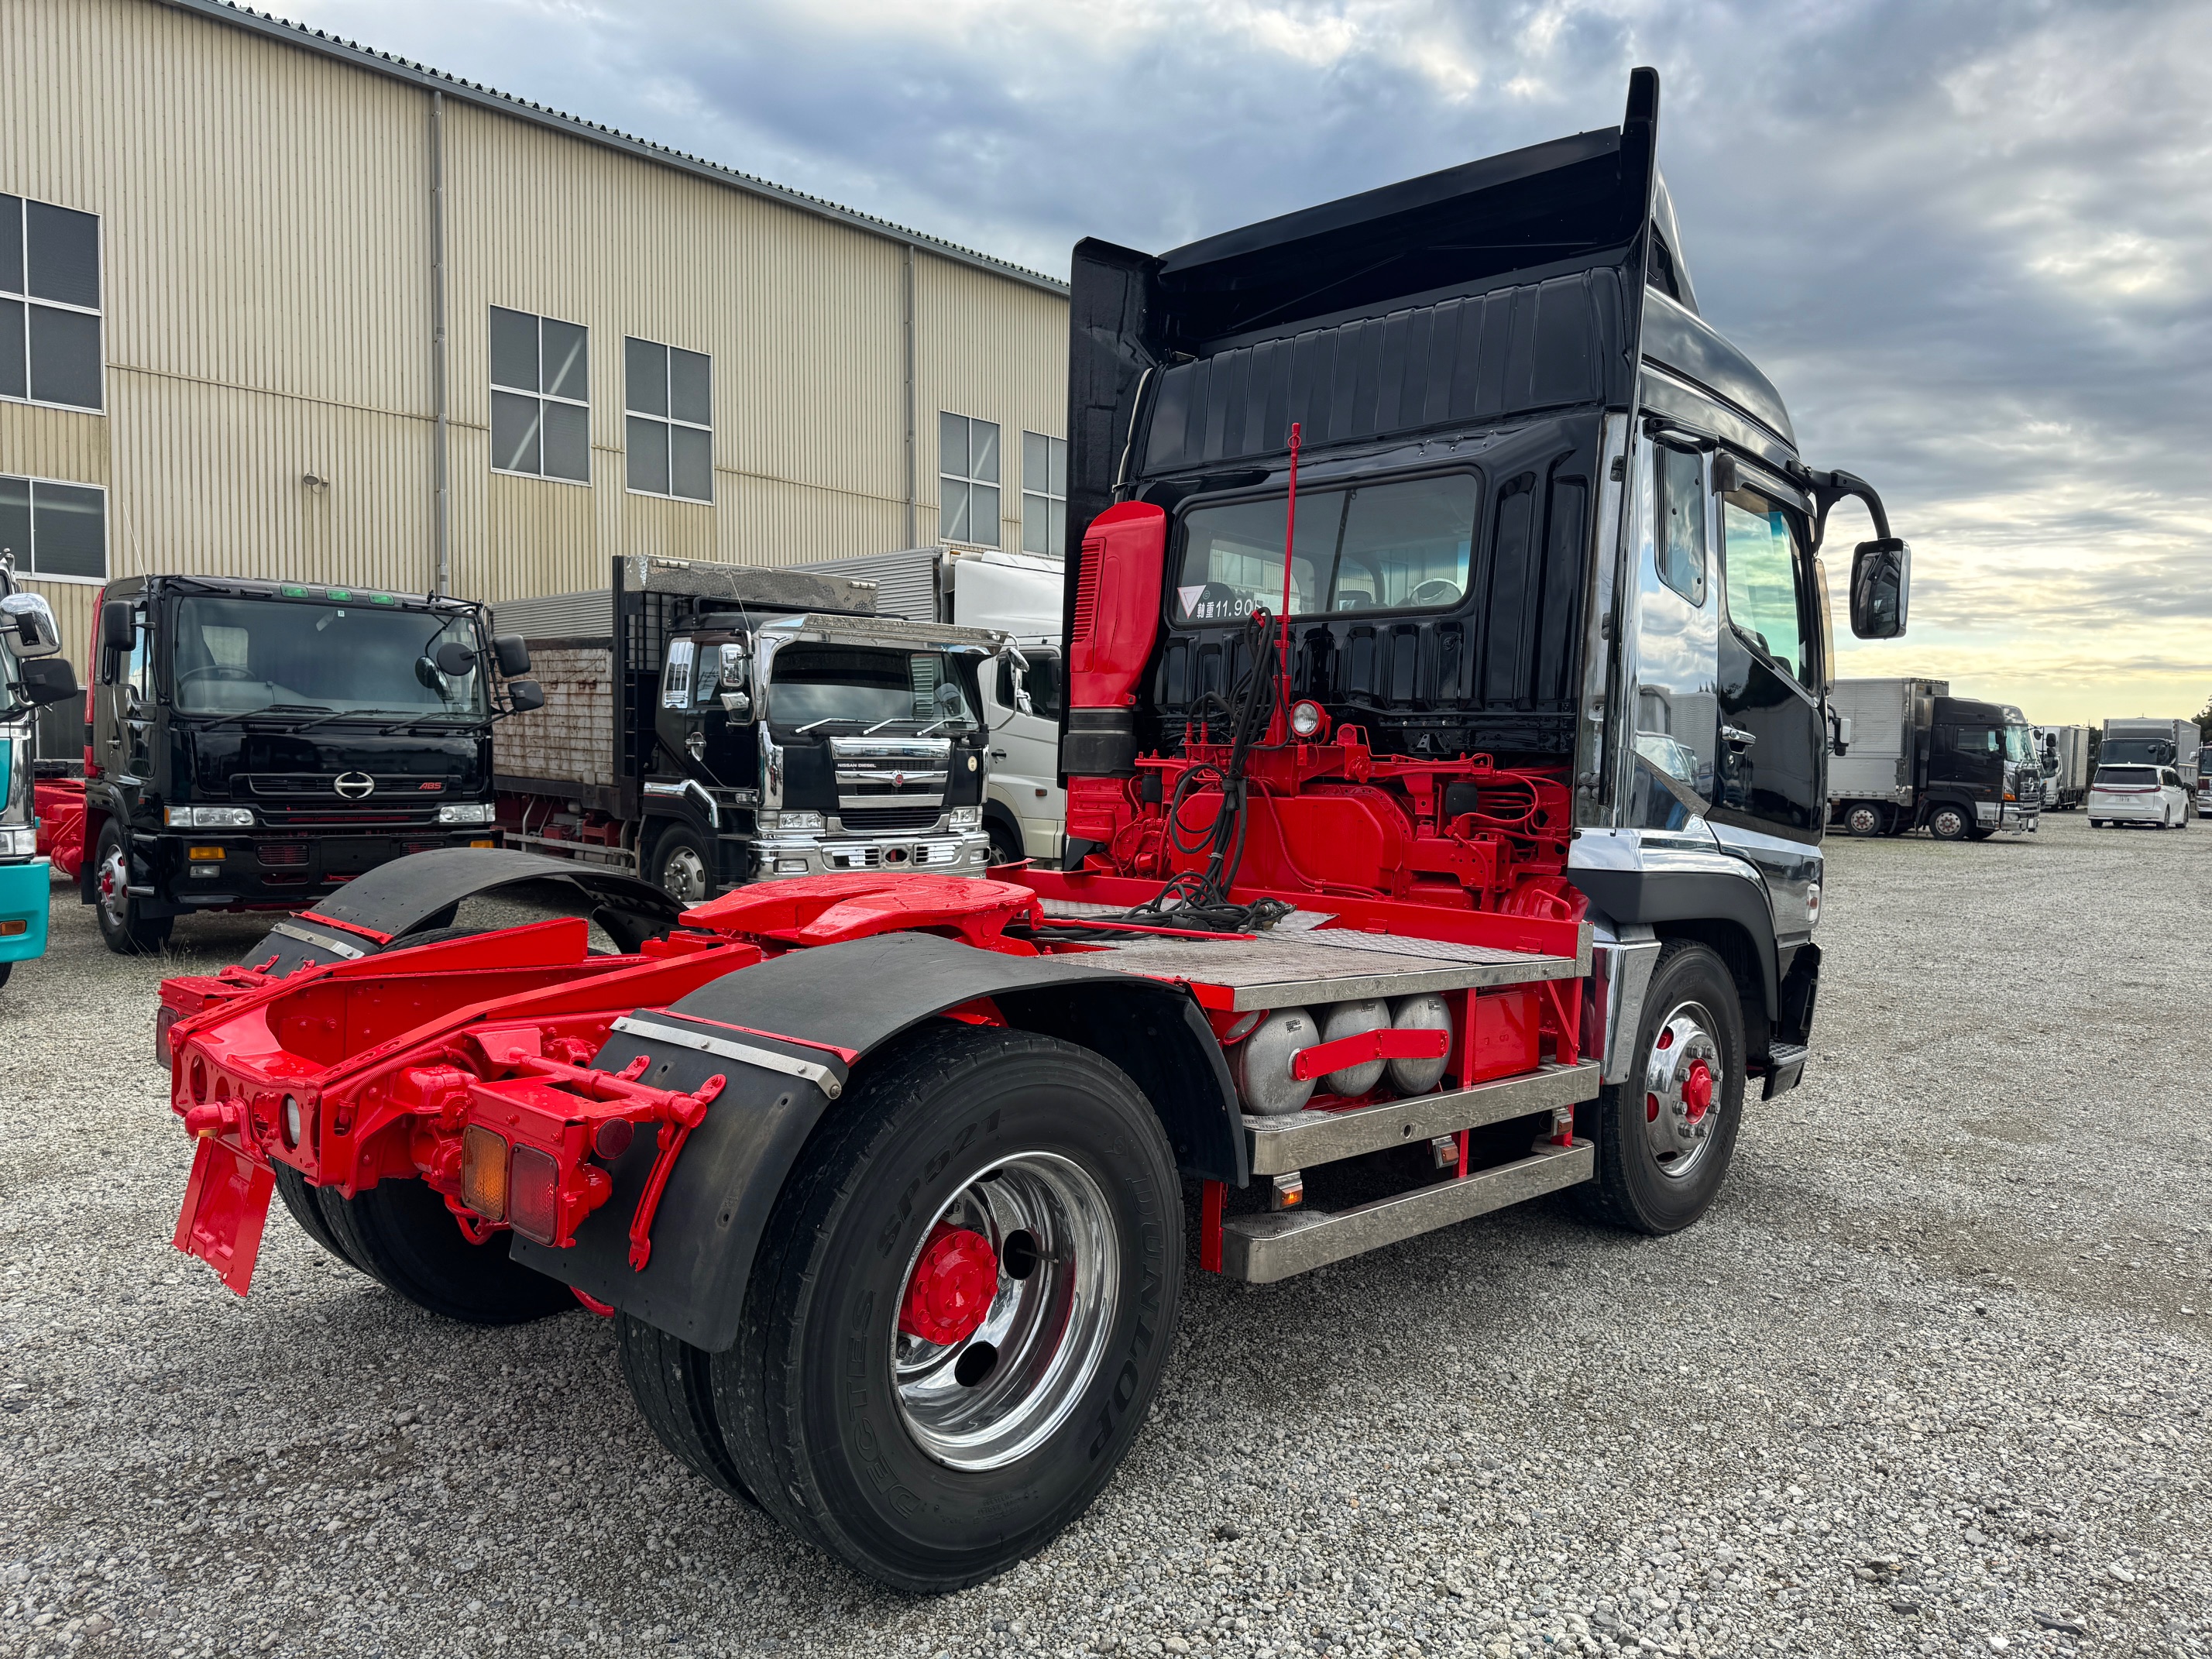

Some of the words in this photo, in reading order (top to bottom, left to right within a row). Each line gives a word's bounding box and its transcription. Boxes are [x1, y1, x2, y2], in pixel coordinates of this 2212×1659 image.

[418, 781, 442, 790] ABS
[847, 1289, 922, 1520] DECTES
[1088, 1172, 1165, 1462] DUNLOP
